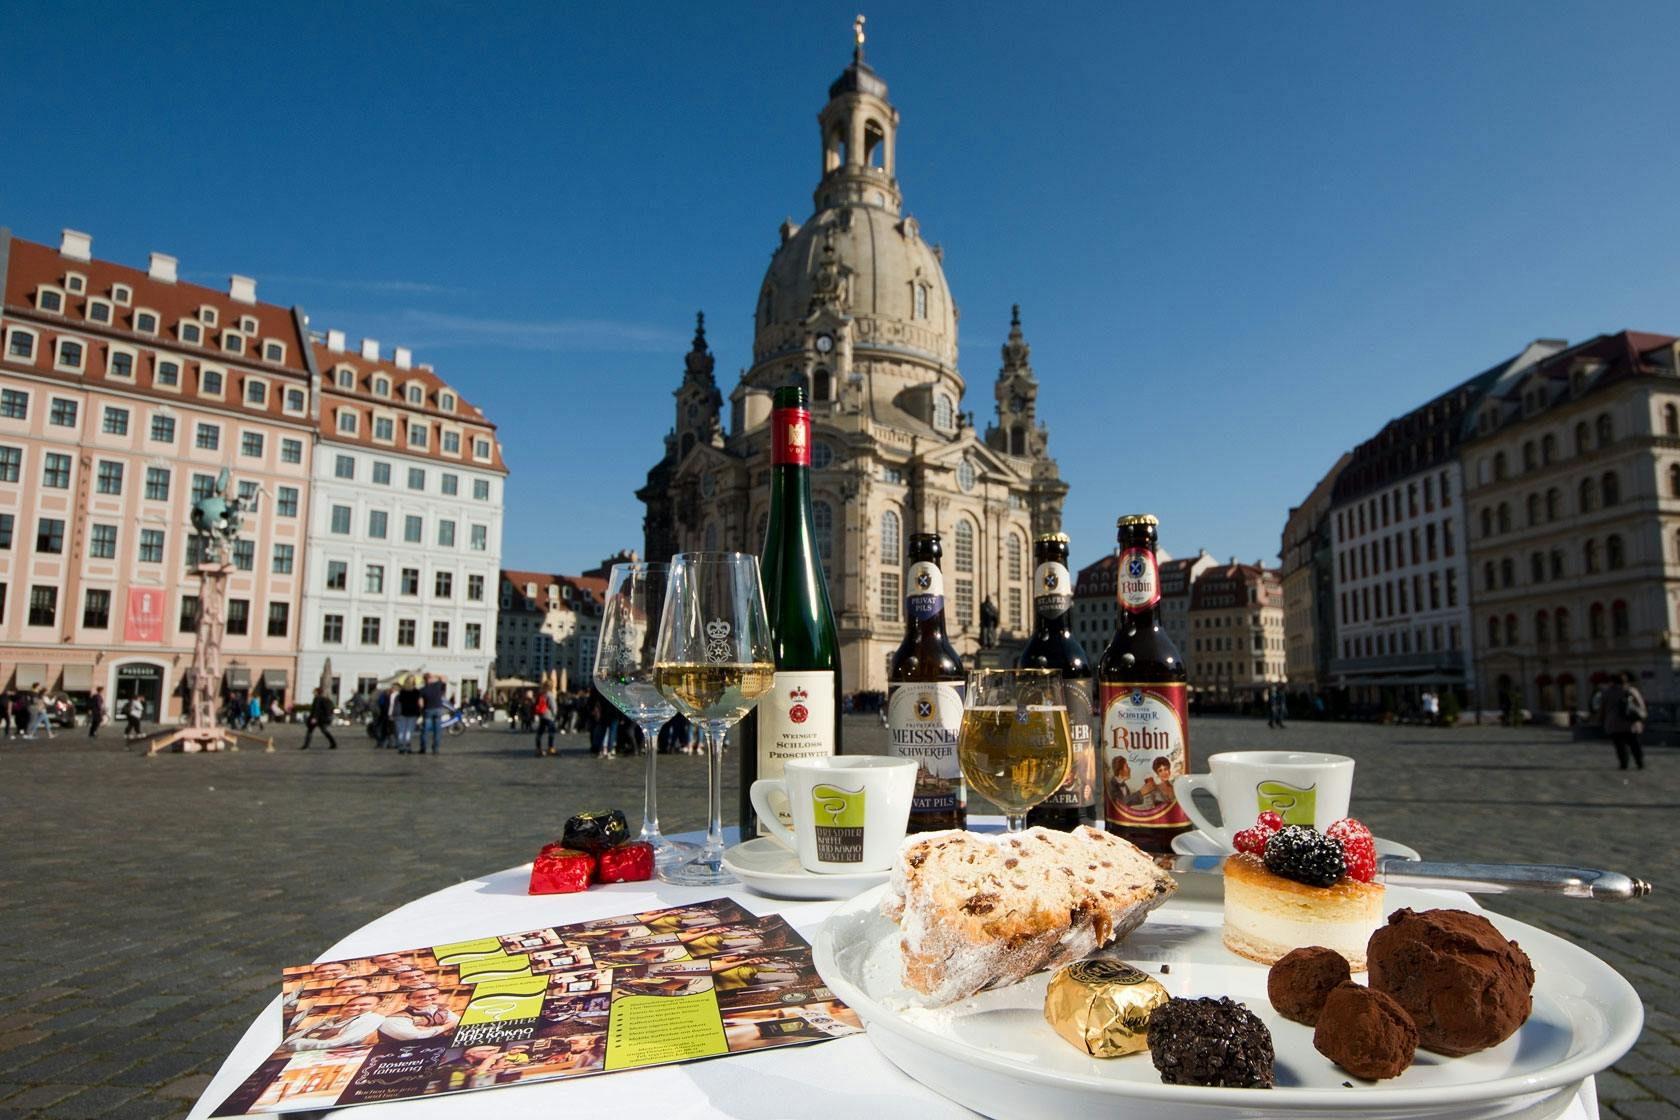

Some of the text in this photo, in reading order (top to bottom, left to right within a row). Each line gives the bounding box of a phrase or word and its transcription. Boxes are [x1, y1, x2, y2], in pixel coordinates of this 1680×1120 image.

[1122, 580, 1152, 593] Rubin
[1111, 725, 1169, 752] Rubin
[899, 747, 952, 760] SCHWERTER
[933, 797, 954, 808] PILS
